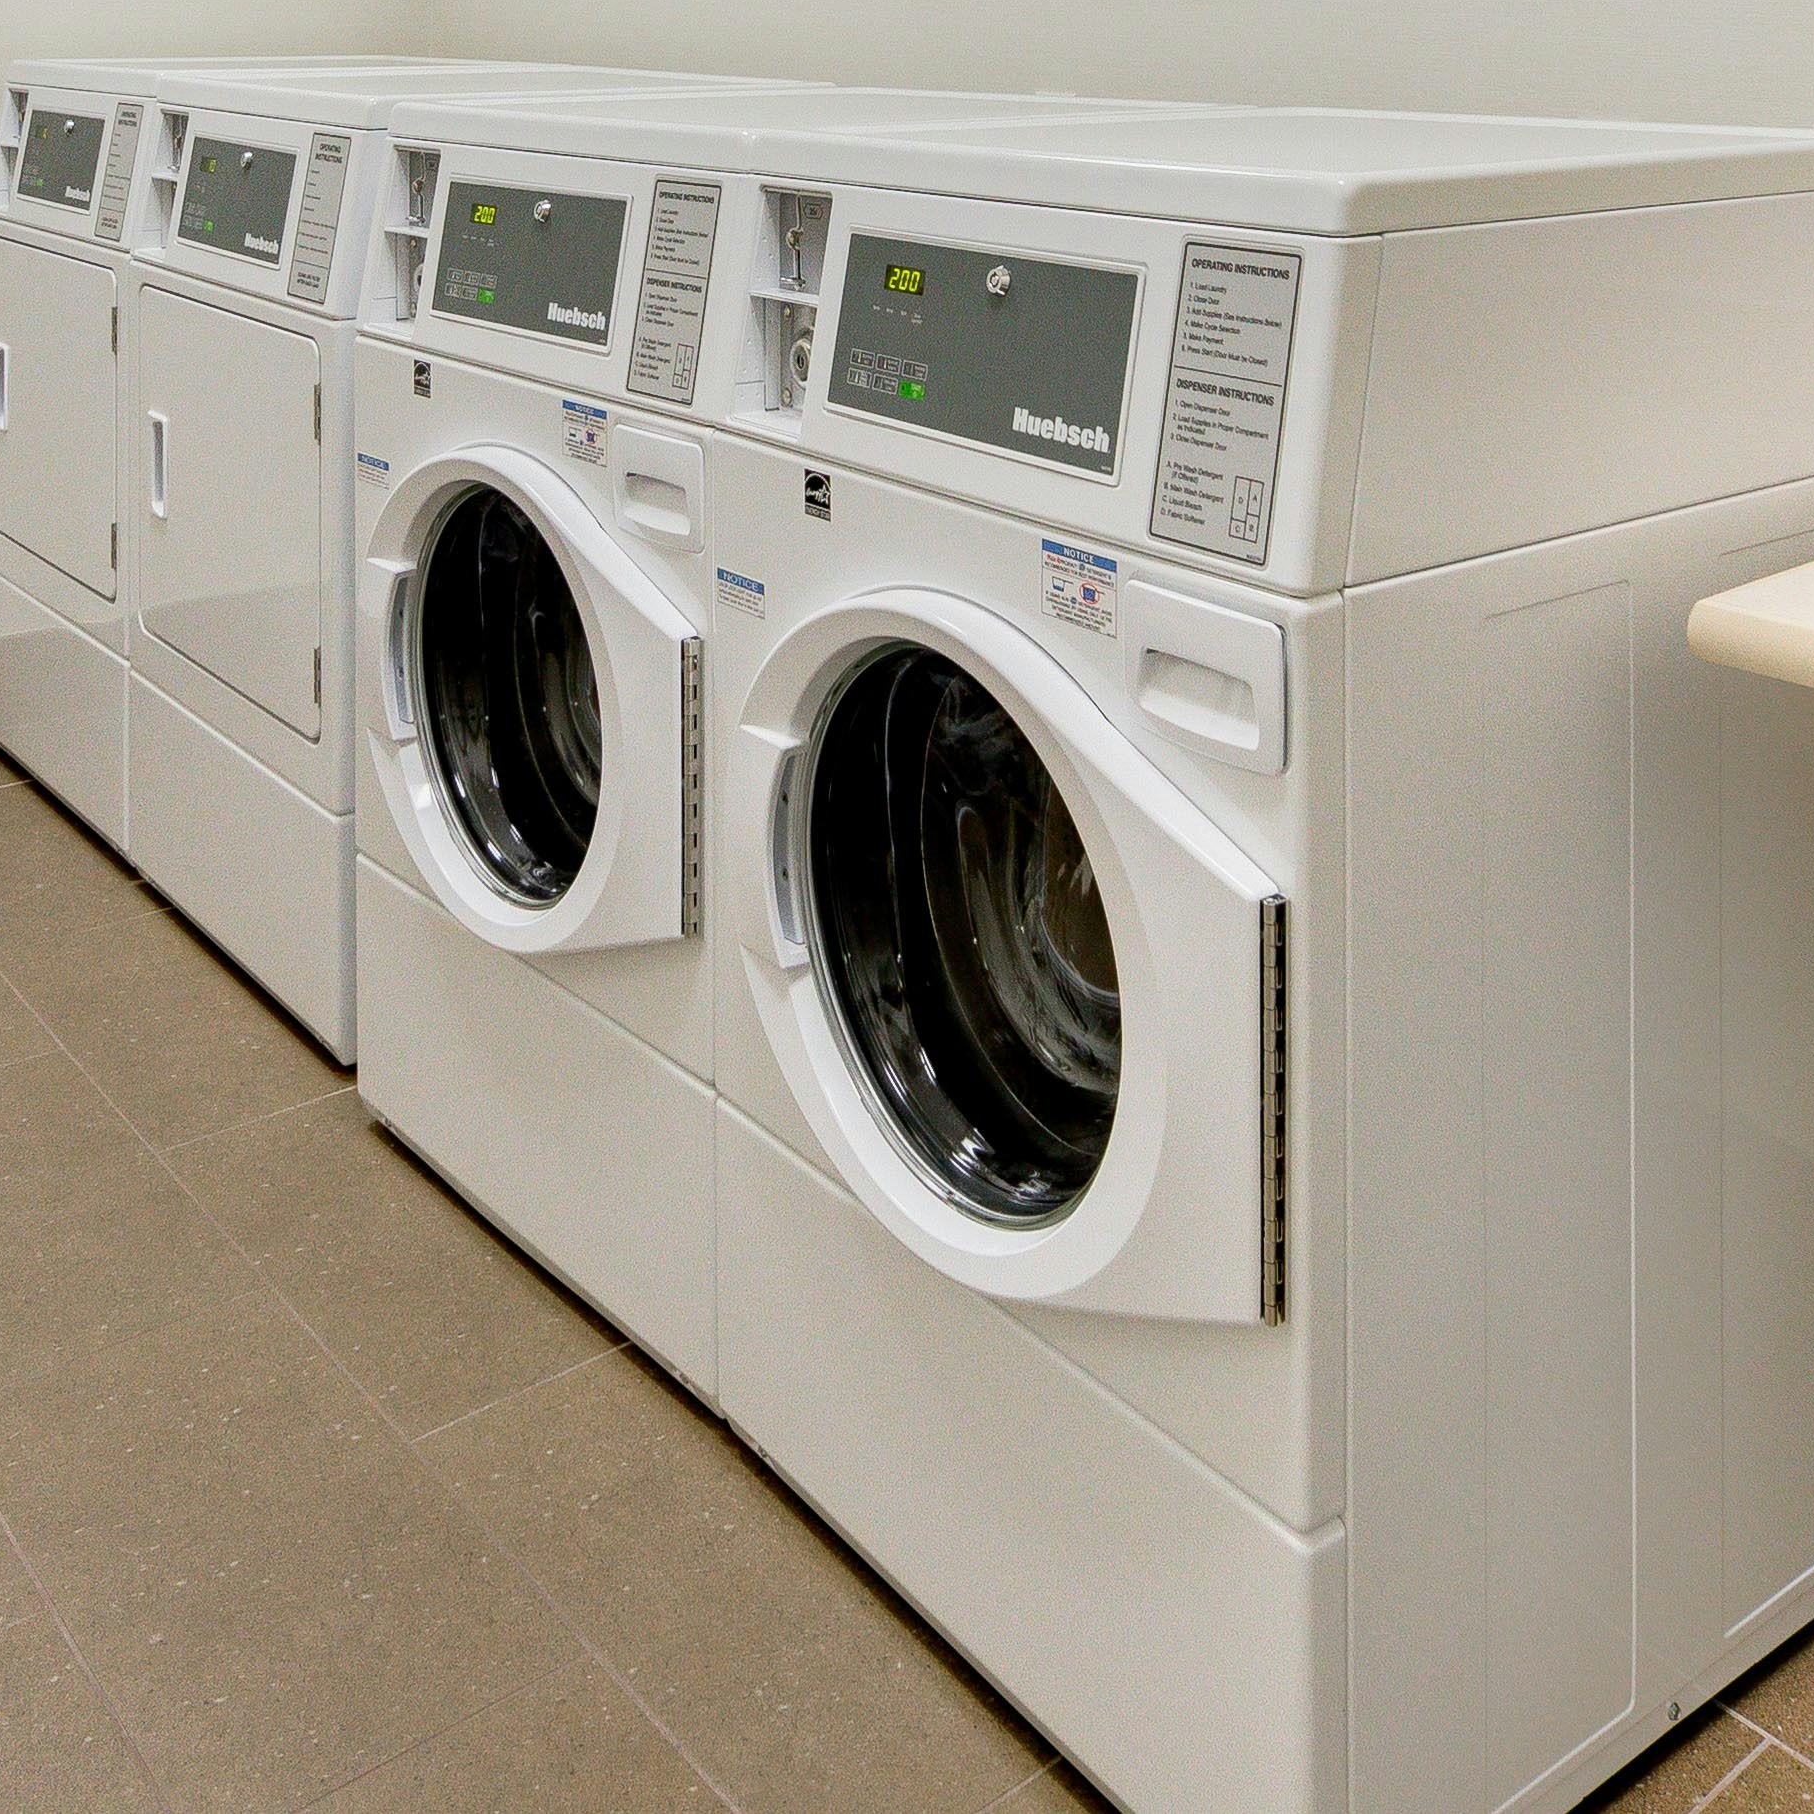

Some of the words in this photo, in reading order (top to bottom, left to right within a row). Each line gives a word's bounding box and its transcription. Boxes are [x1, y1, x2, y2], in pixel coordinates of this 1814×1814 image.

[474, 205, 495, 224] 200
[1192, 258, 1233, 273] OPERATING
[1235, 264, 1290, 280] INSTRUCTIONS
[890, 268, 921, 292] 200
[547, 302, 606, 330] Huebsch
[1177, 378, 1217, 396] DISPENSER
[1218, 385, 1274, 405] INSTRUCTIONS
[1012, 407, 1111, 453] Huebsch
[1238, 496, 1244, 504] D
[1235, 525, 1240, 533] C
[1064, 547, 1094, 564] NOTICE
[723, 571, 759, 590] NOTICE
